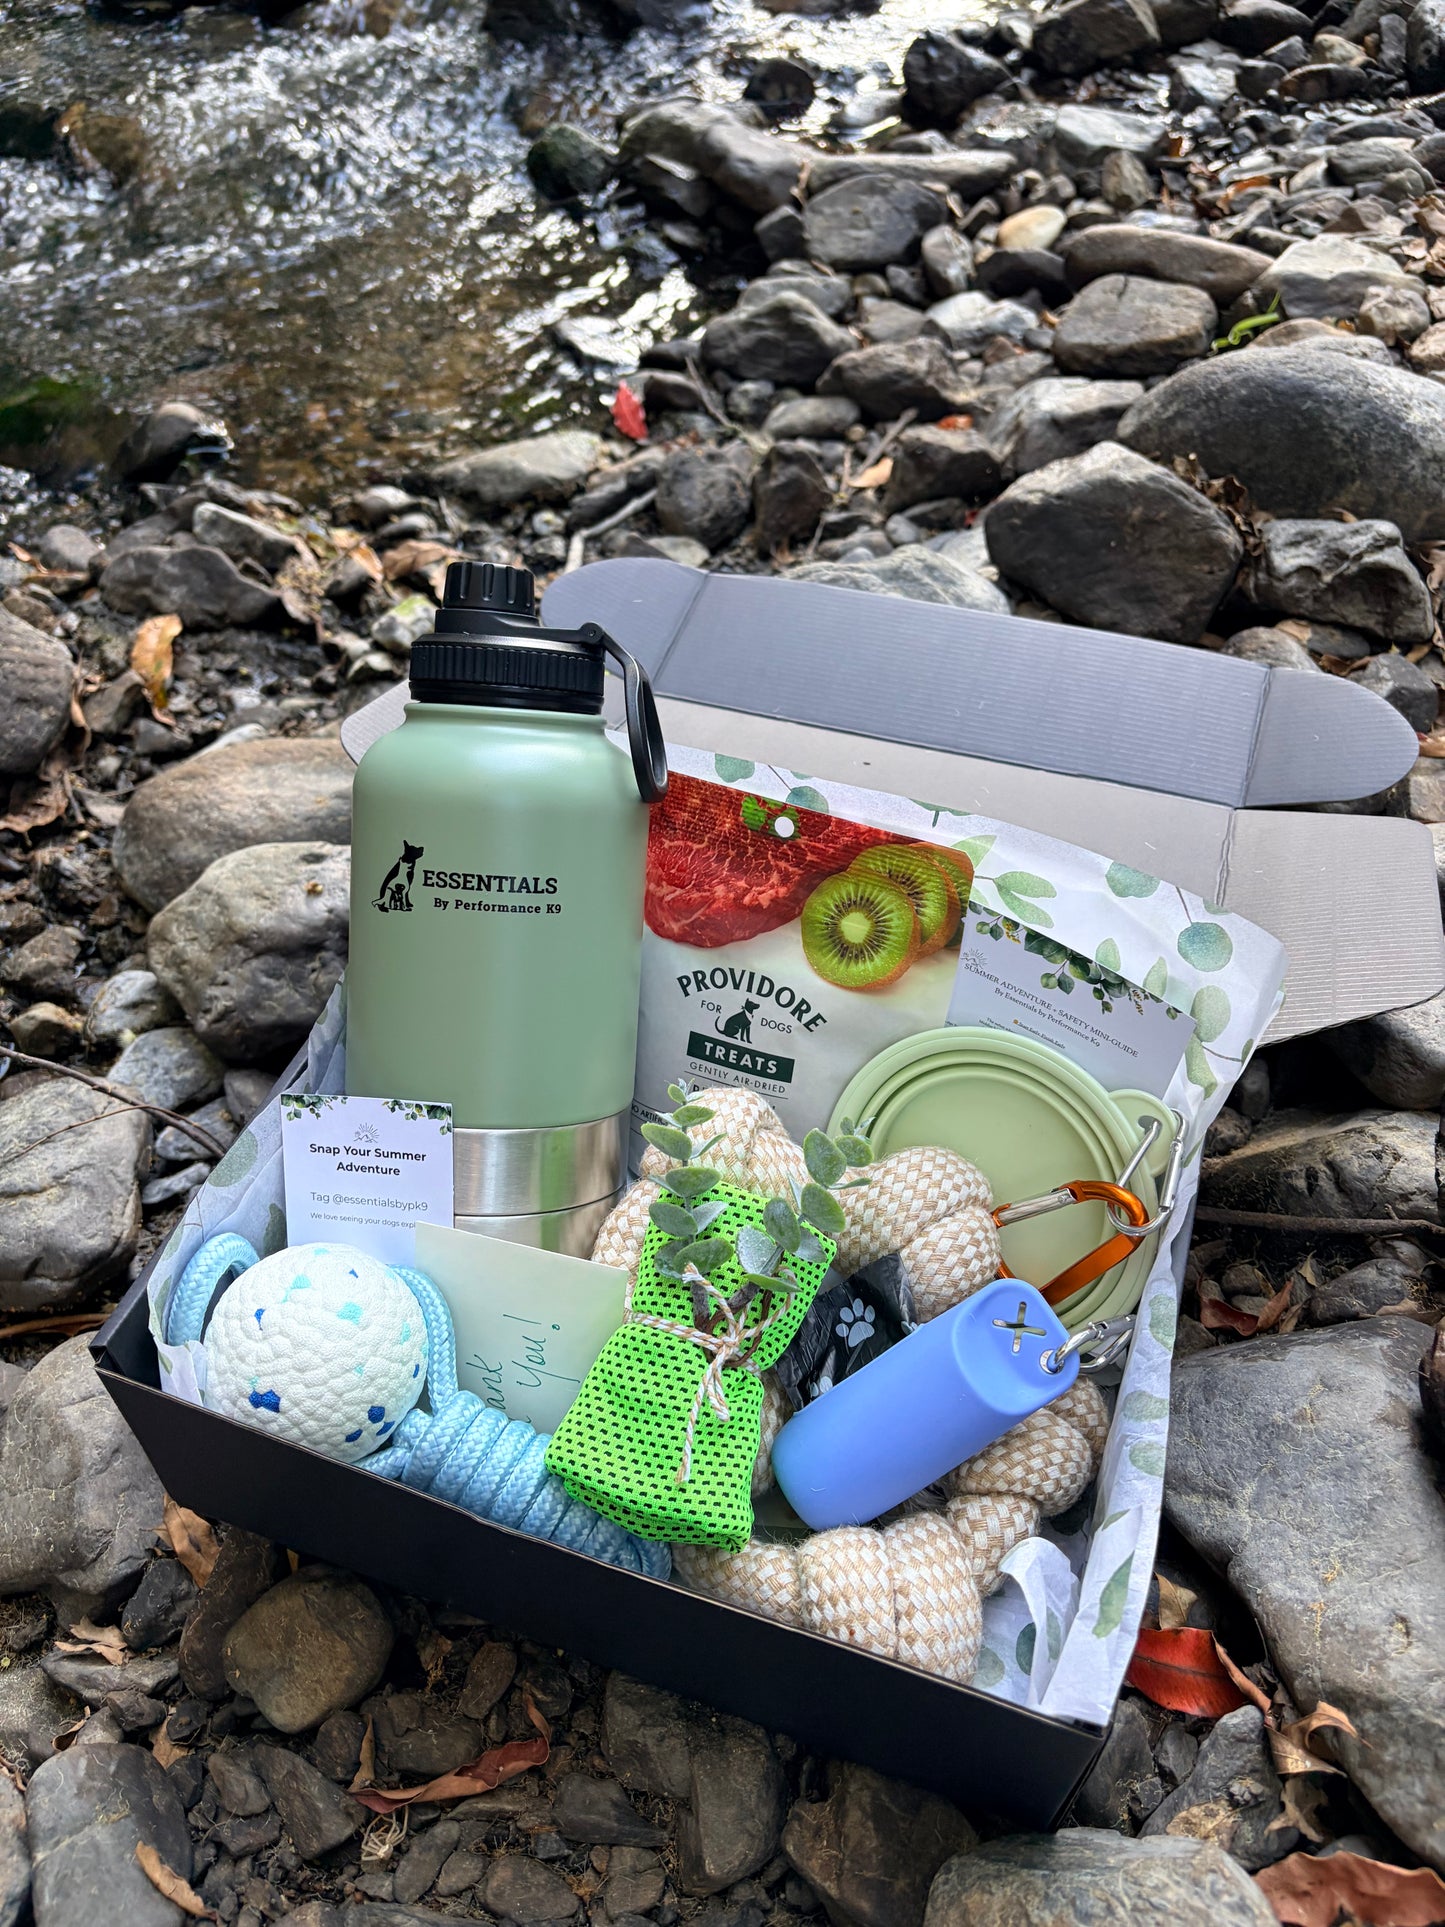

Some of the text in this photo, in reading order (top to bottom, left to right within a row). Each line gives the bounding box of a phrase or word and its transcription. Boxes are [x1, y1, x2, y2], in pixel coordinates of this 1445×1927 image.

[422, 869, 558, 895] ESSENTIALS
[433, 897, 562, 914] By Performance K9
[676, 967, 827, 1033] PROVIDORE
[964, 963, 1000, 984] SUMMER
[1000, 981, 1052, 1011] ADVENTURE
[1058, 1009, 1090, 1030] SAFETY
[1090, 1026, 1139, 1058] MINI-GUIDE
[994, 987, 1004, 997] By
[1004, 992, 1037, 1014] Essentials
[1037, 1009, 1047, 1019] by
[1047, 1014, 1090, 1041] Performance
[700, 1000, 792, 1035] FOR DOGS
[704, 1042, 778, 1075] TREATS
[689, 1061, 786, 1095] GENTLY AIR-DRIED
[309, 1143, 427, 1162] Snap Your Summer
[336, 1161, 401, 1176] Adventure
[310, 1192, 428, 1211] Tag @essentialsbypk9
[310, 1212, 322, 1220] We
[339, 1215, 363, 1225] seeing
[381, 1219, 400, 1228] dogs
